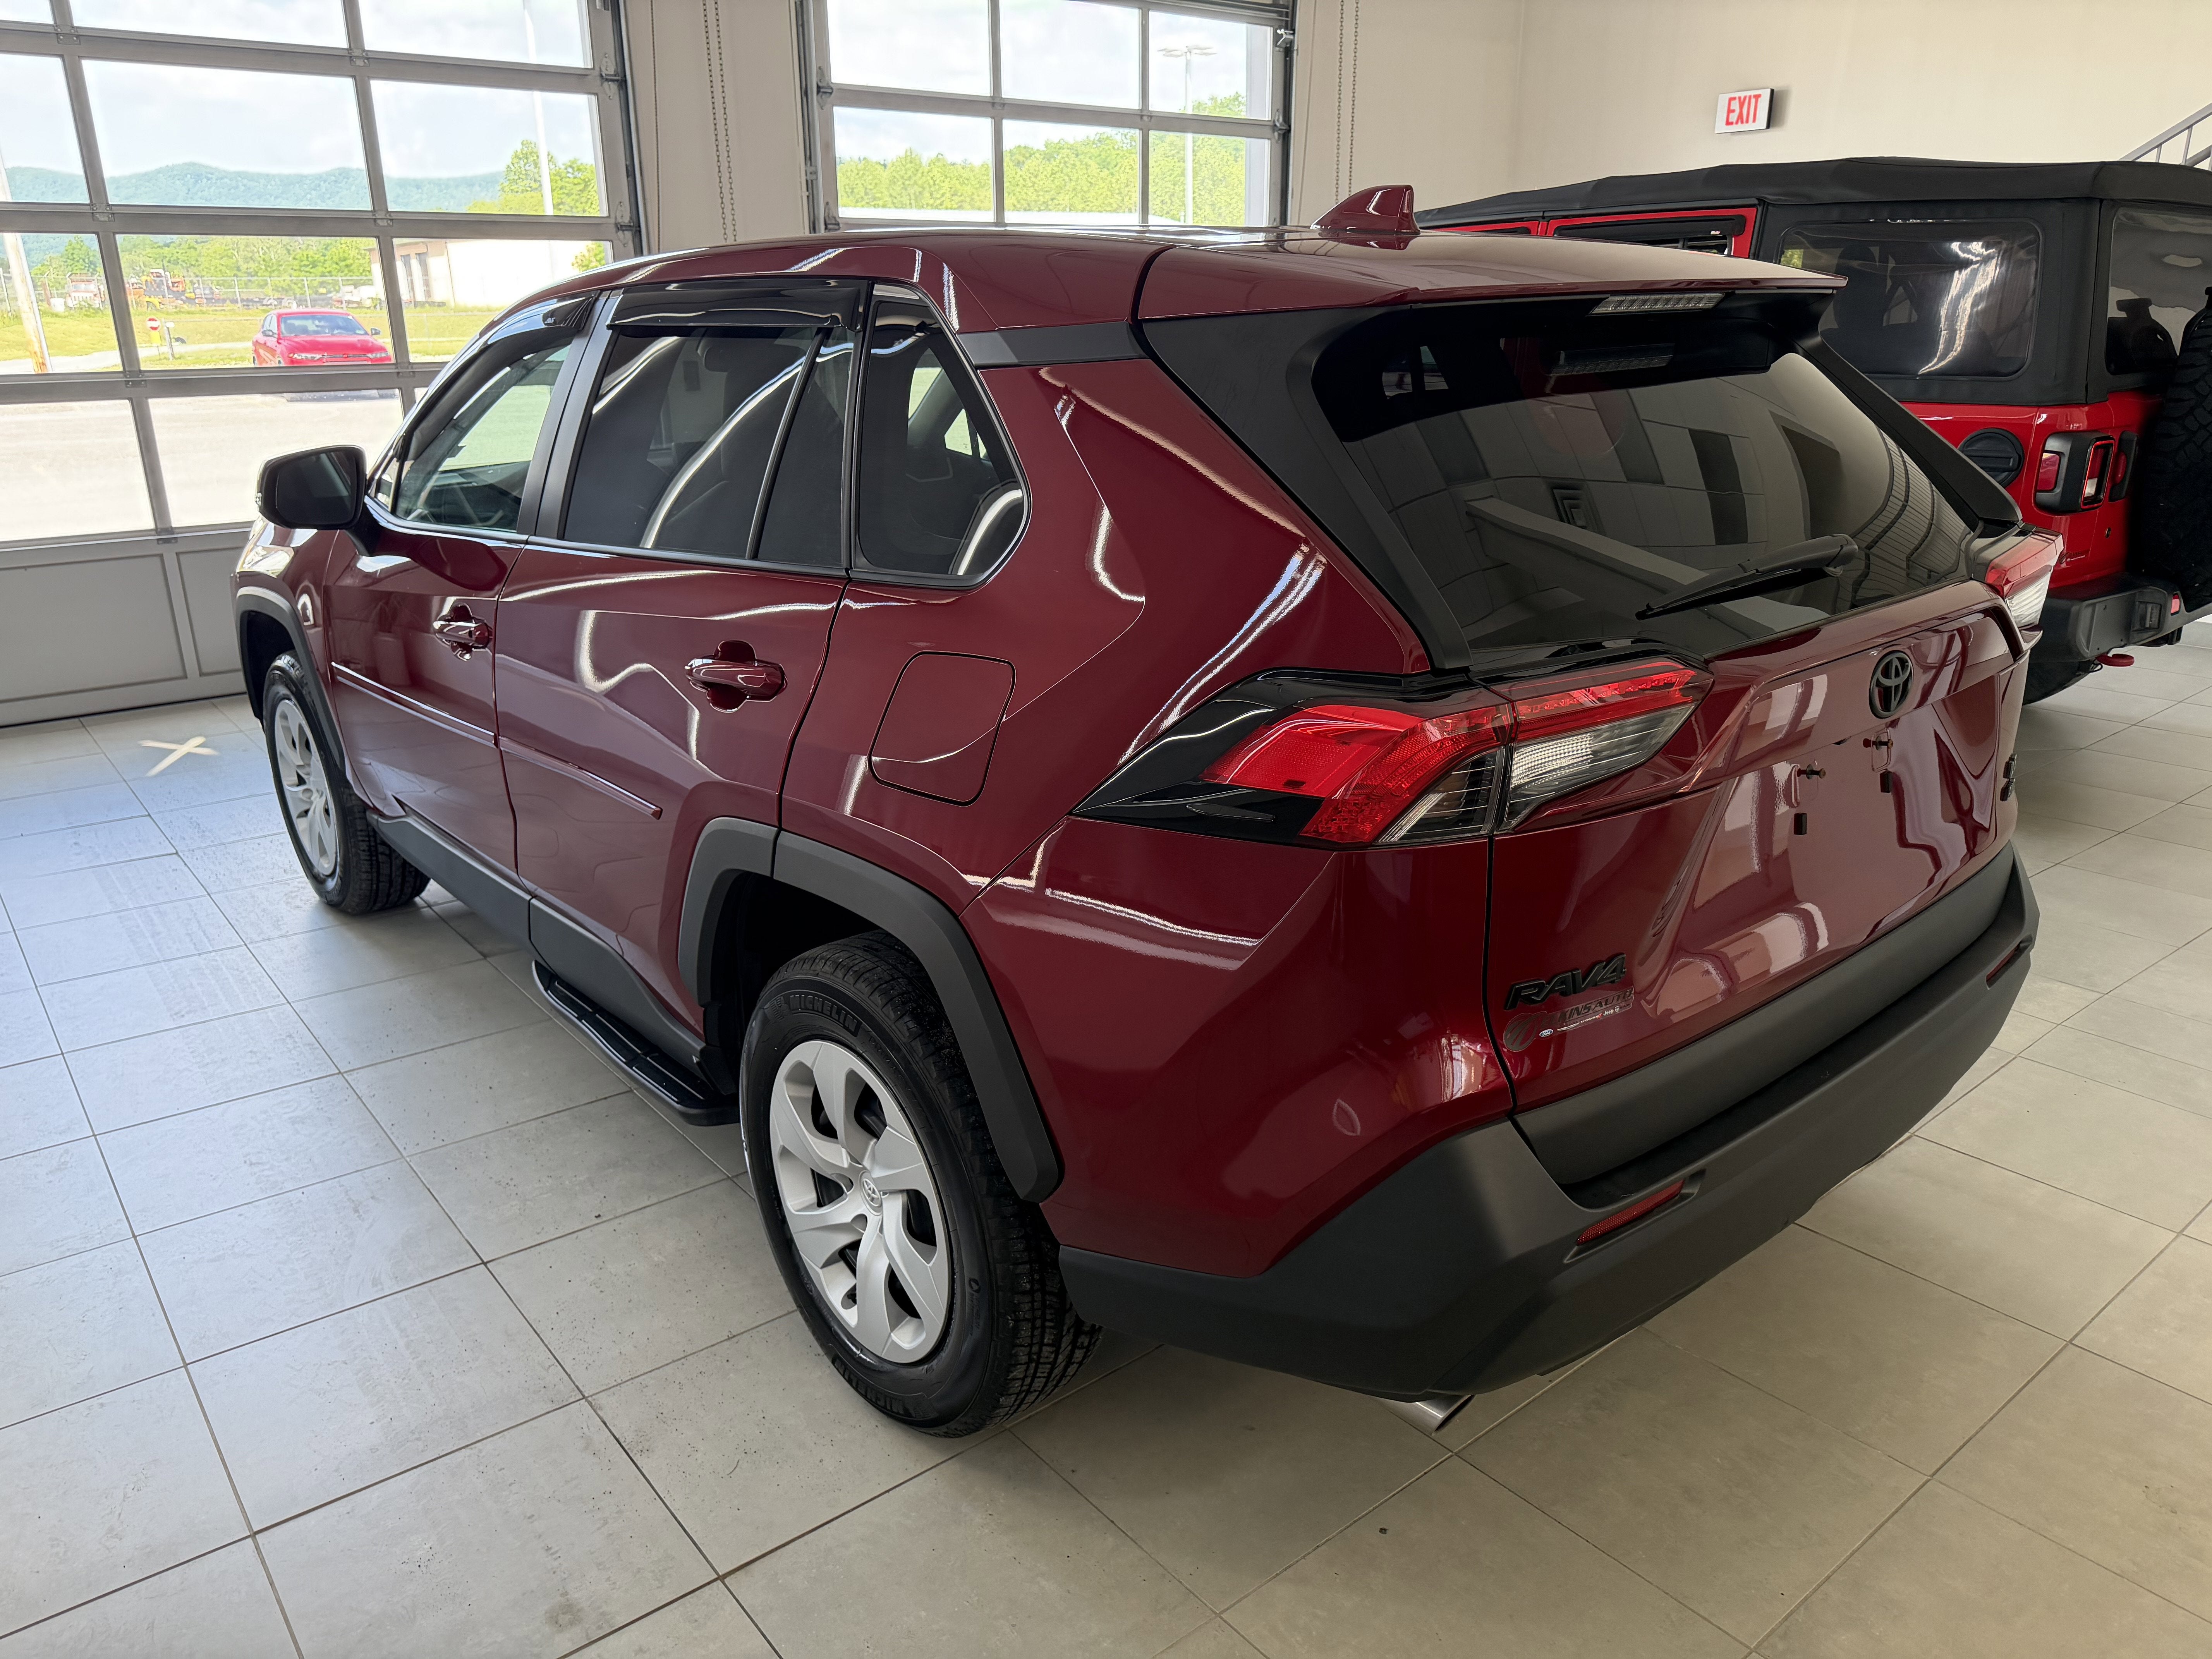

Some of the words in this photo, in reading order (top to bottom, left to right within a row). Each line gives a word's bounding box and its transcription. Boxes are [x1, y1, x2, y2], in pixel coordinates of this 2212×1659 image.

[1725, 94, 1762, 126] EXIT
[1504, 953, 1626, 1011] RAV4
[790, 994, 857, 1032] MICHELIN
